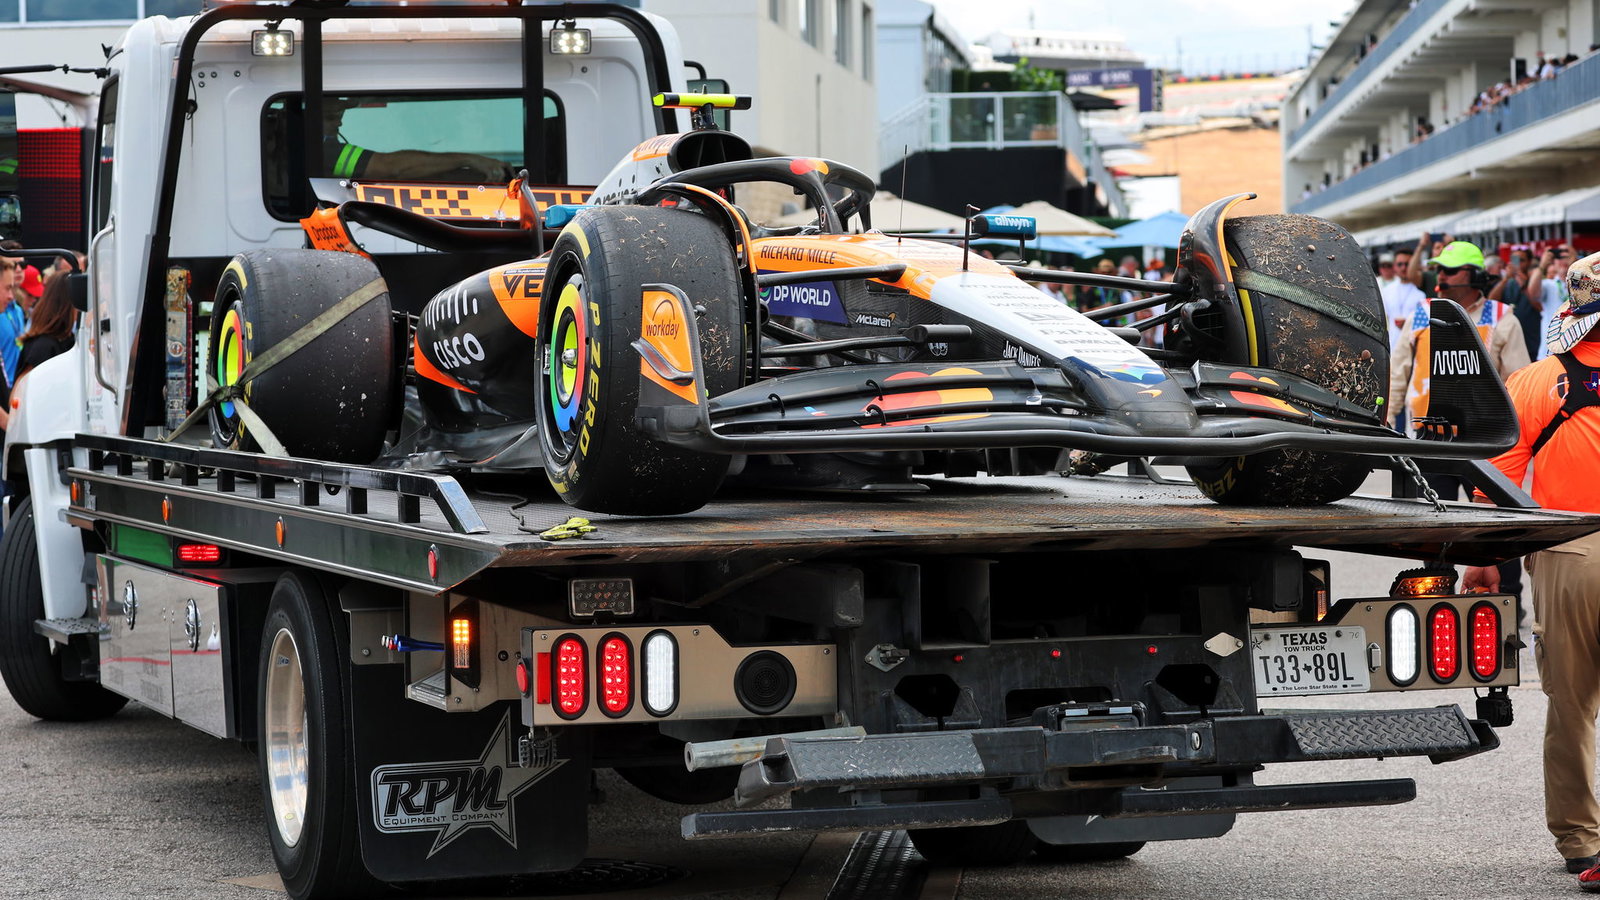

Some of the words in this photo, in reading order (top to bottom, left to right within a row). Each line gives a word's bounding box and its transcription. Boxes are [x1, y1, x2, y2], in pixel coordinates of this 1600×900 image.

[994, 215, 1031, 231] allwyn
[760, 245, 805, 261] RICHARD
[806, 248, 838, 265] MILLE
[502, 274, 545, 300] VE
[773, 285, 789, 302] DP
[790, 286, 831, 307] WORLD
[590, 302, 601, 326] P
[855, 312, 891, 328] McLaren
[645, 319, 680, 340] workday
[1002, 340, 1018, 359] JACK
[1433, 350, 1481, 375] ARROW
[579, 337, 601, 457] ZERO
[1280, 632, 1328, 646] TEXAS
[378, 766, 508, 817] RPM
[383, 815, 447, 826] EQUIPMENT
[452, 812, 505, 822] COMPANY
